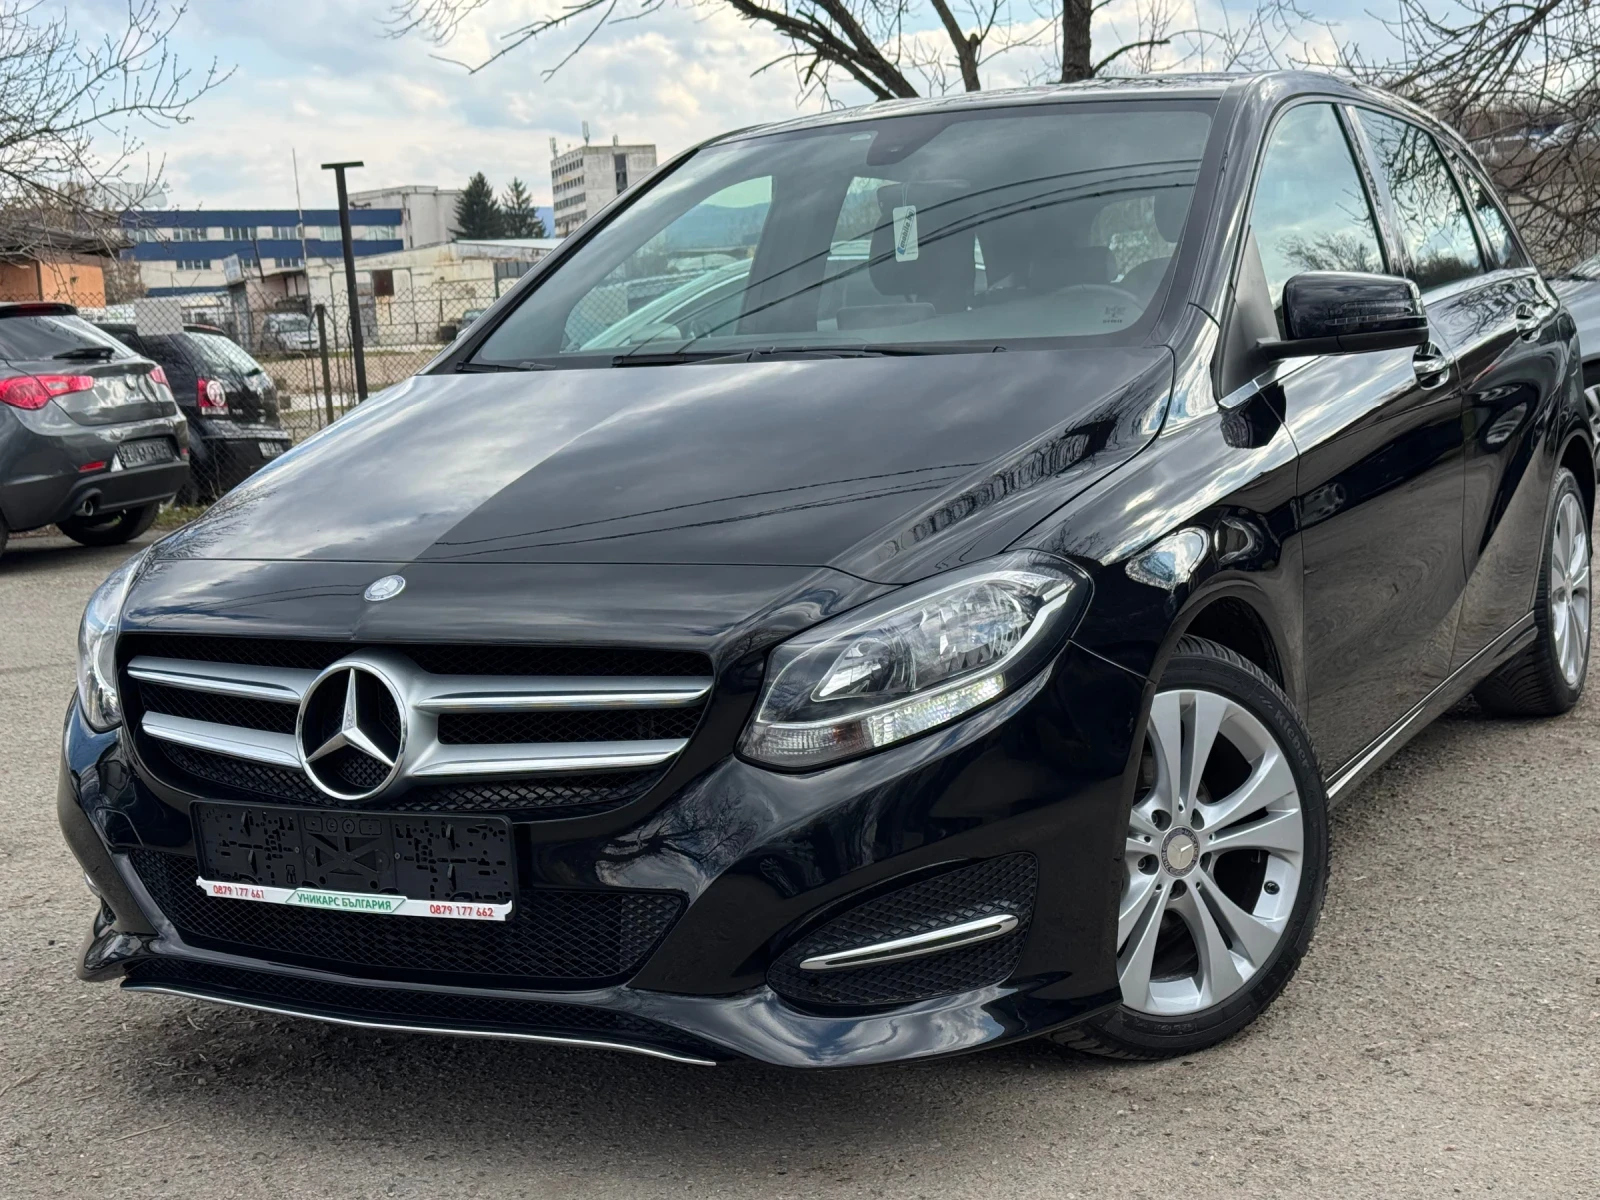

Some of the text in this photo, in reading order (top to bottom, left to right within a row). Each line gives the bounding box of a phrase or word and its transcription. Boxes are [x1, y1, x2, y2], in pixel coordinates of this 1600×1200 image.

[1274, 709, 1310, 769] Kleber
[213, 885, 265, 899] 0879 177 661
[297, 893, 392, 910] УНИКАРС БЪЛГАРИЯ
[429, 904, 494, 917] 0879 177 662
